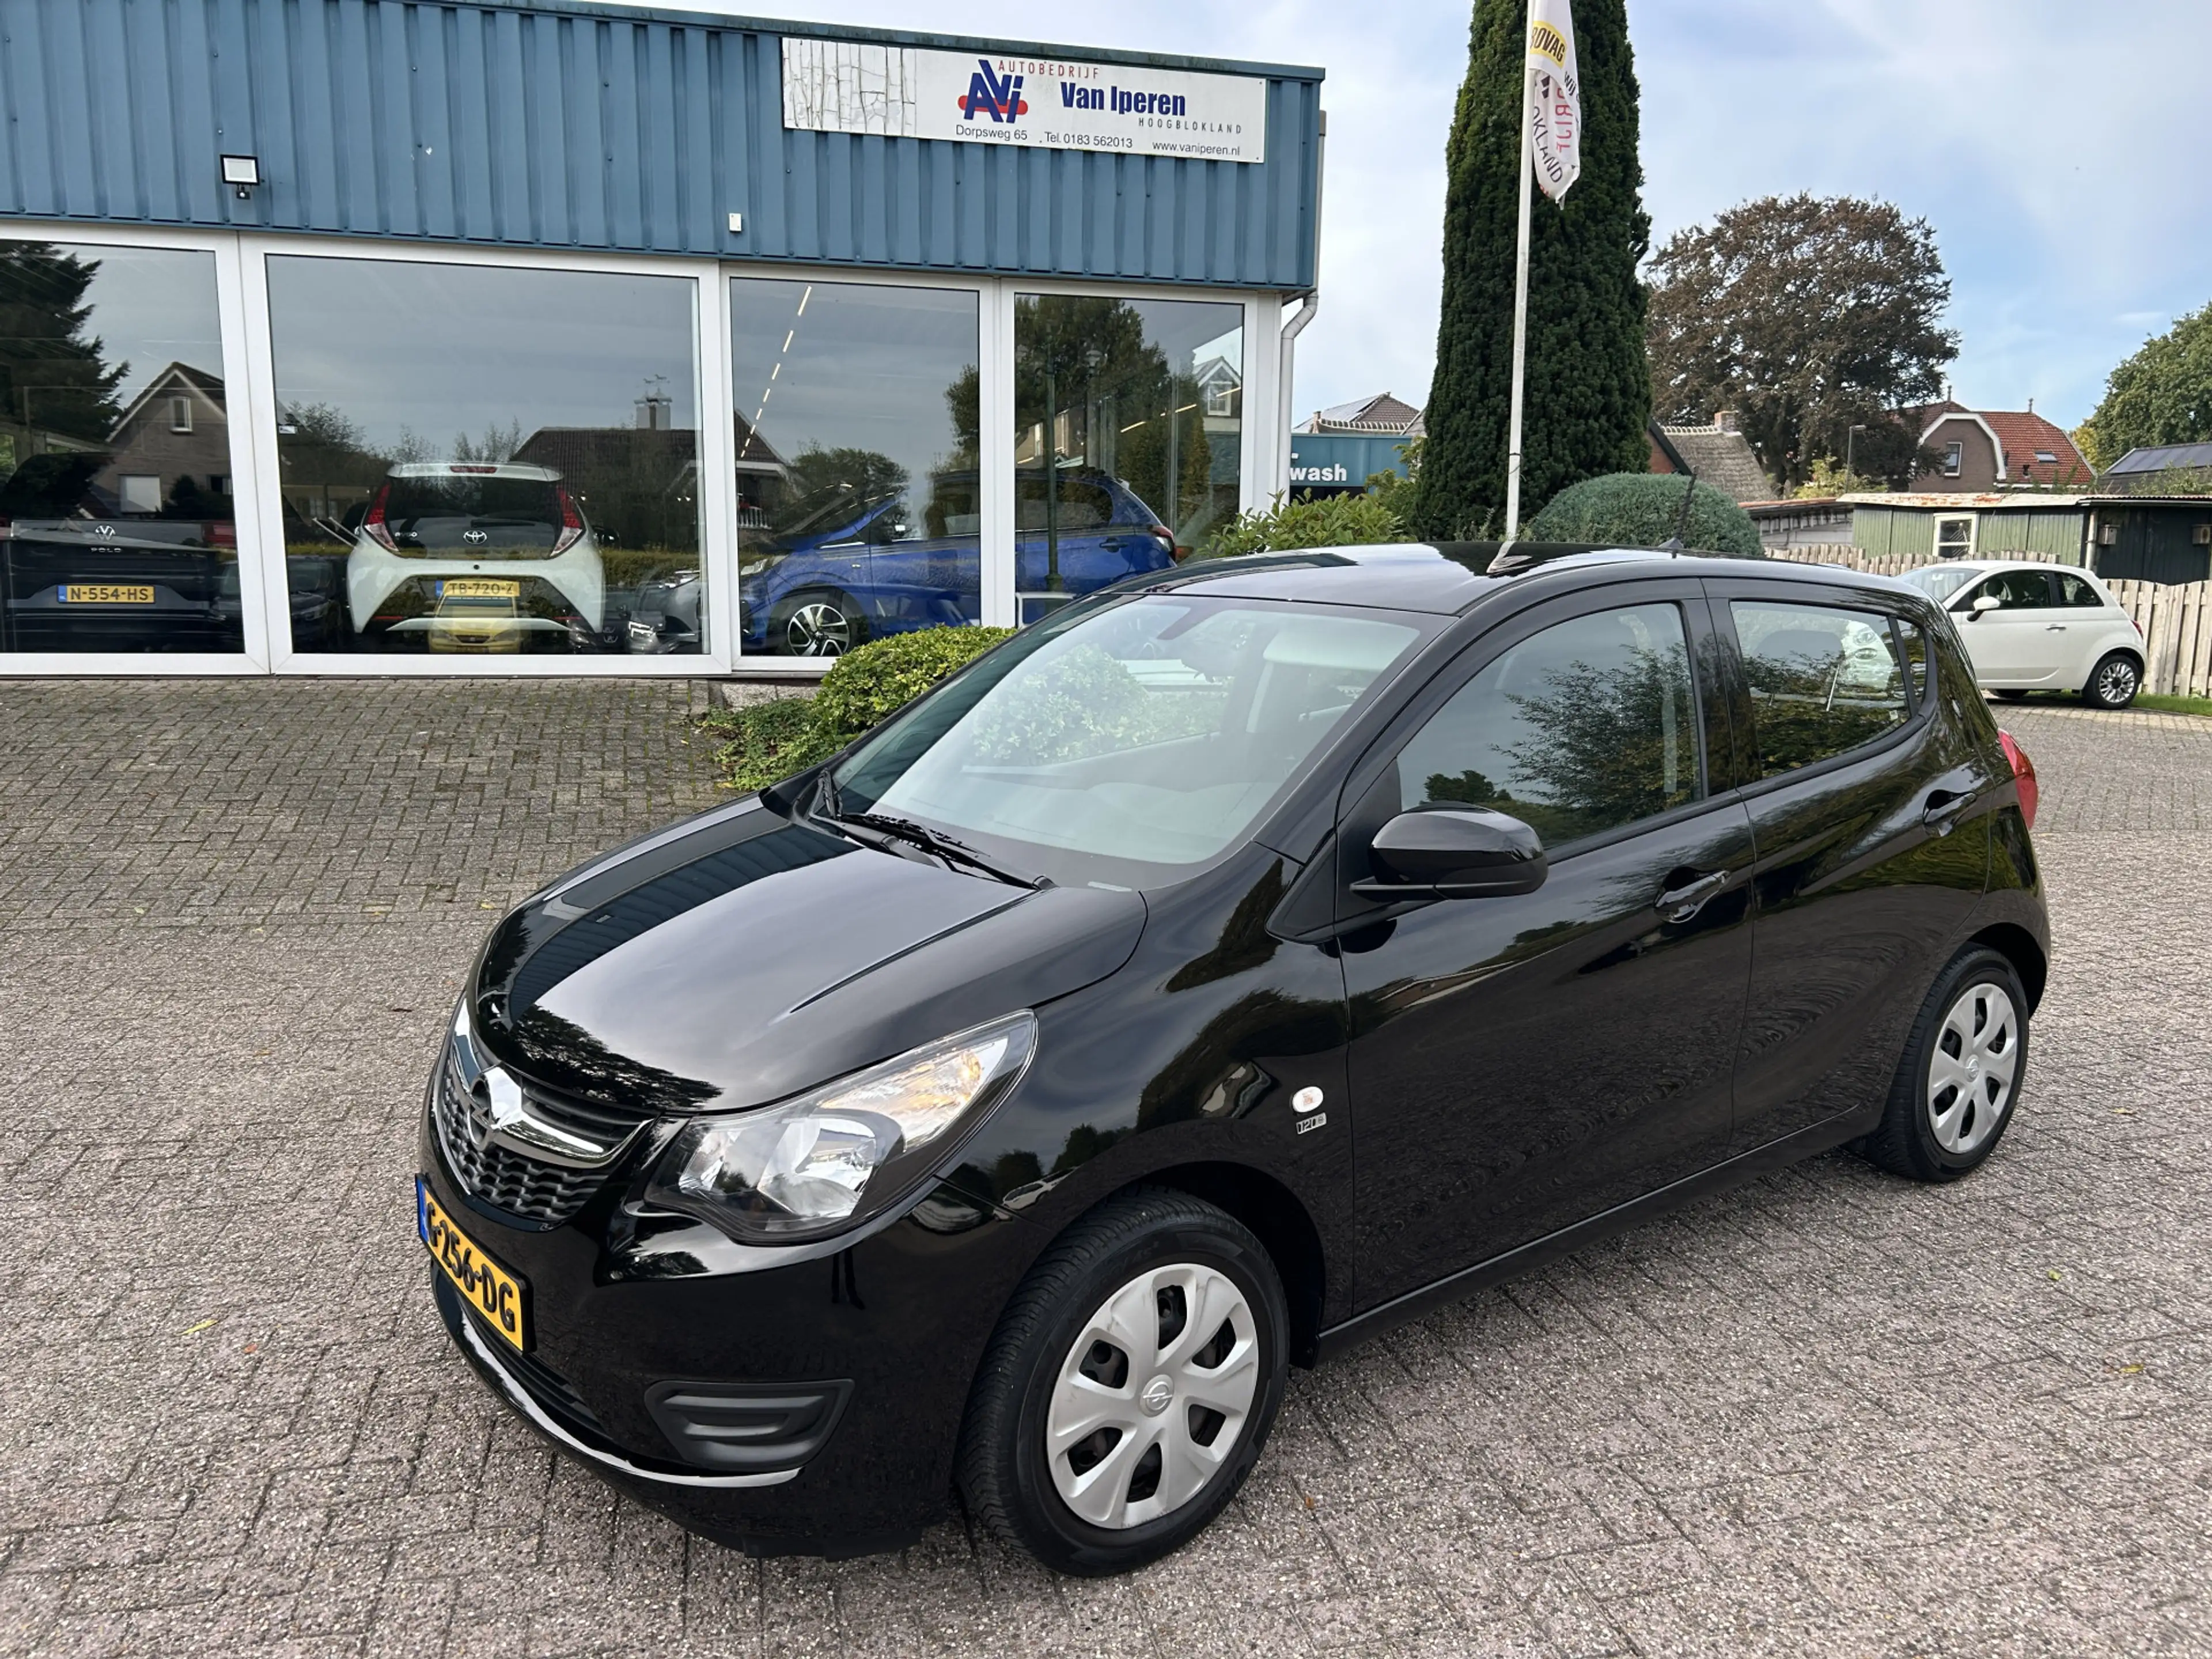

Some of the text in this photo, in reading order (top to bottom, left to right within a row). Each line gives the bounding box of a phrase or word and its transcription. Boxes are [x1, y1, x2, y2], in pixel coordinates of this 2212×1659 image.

[998, 60, 1099, 79] AUTOBEDRIJF
[1060, 81, 1185, 116] Van Iperen
[1138, 117, 1241, 134] HOOGBLOKLAND
[956, 124, 1132, 148] Dorpsweg 65 Tel. 0183 562013
[1152, 142, 1240, 156] www.vaniperen.nl
[1289, 463, 1347, 482] wash
[70, 587, 149, 601] N-554-HS
[449, 583, 514, 595] TB-720-Z
